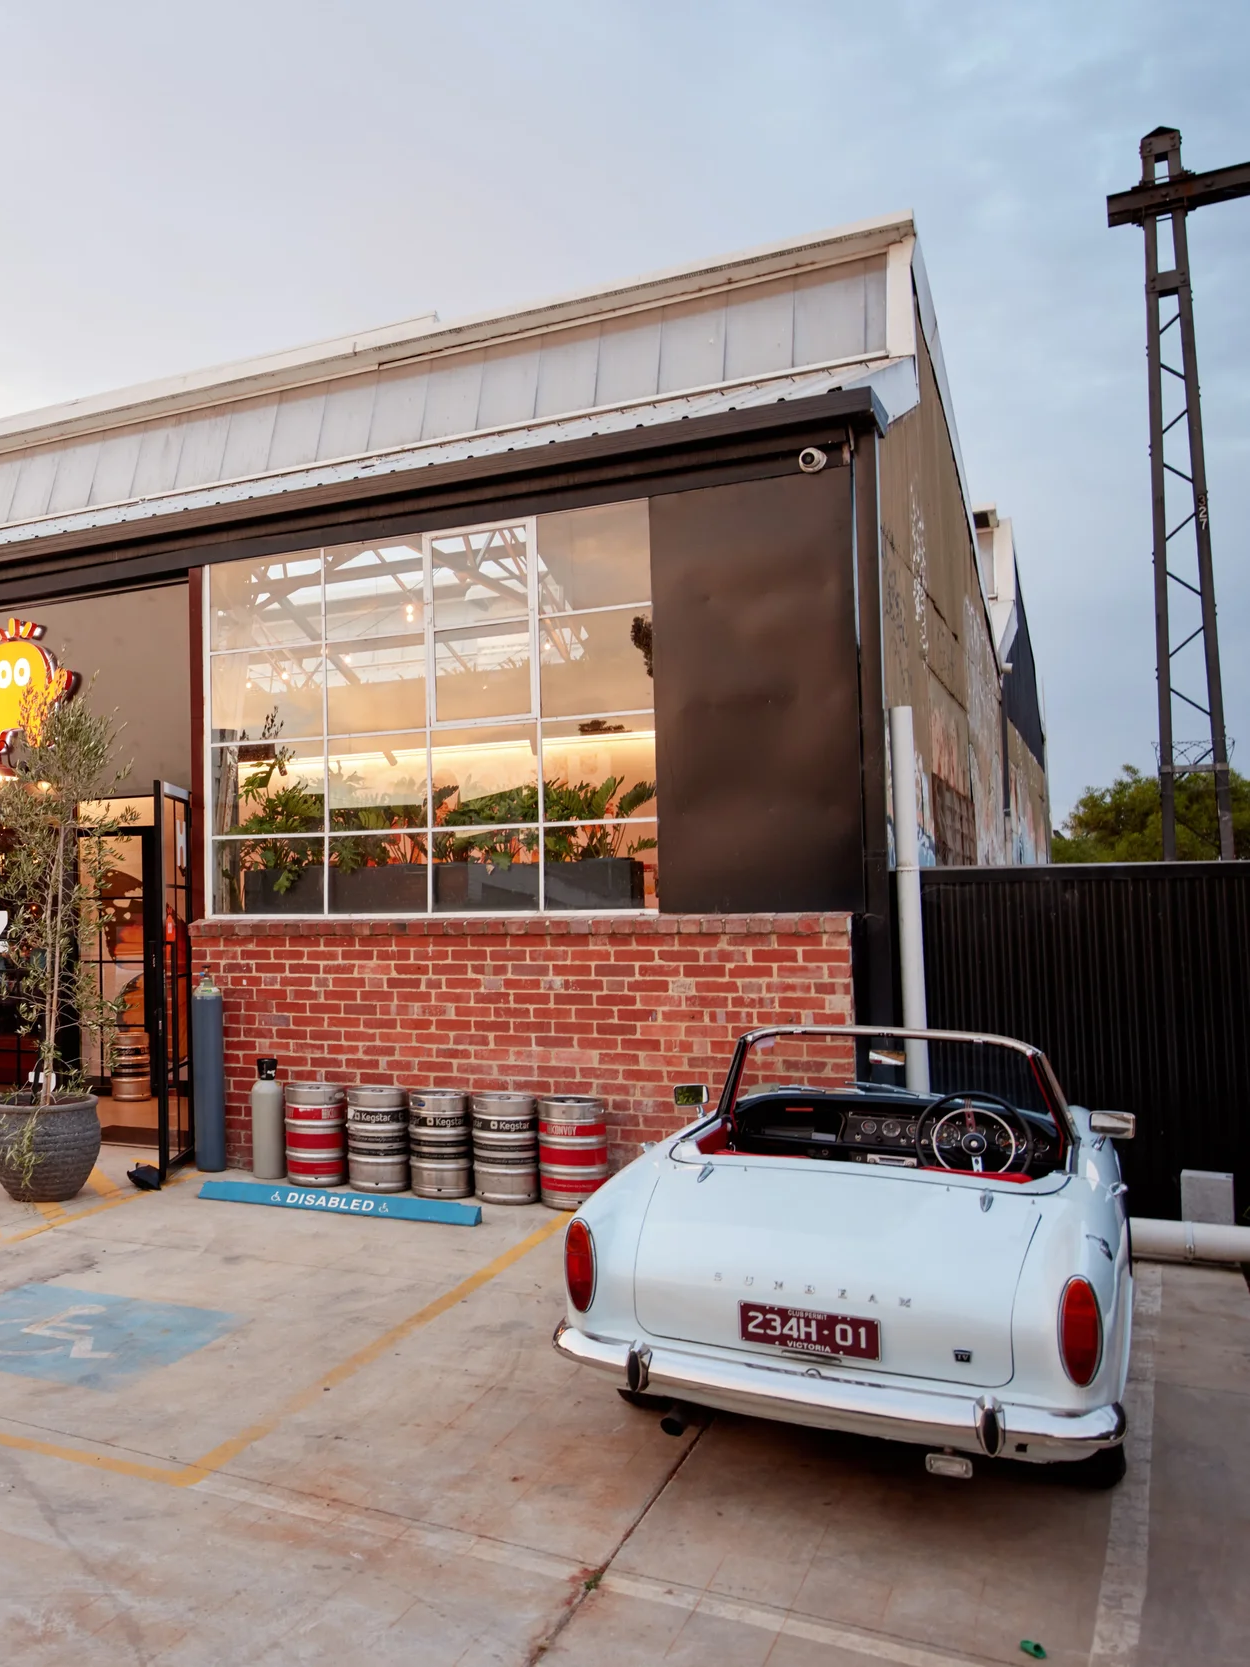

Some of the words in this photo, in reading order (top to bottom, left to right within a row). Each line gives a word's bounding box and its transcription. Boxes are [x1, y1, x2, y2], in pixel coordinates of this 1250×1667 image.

[361, 1113, 392, 1123] Kegstar
[435, 1117, 464, 1128] Kegstar
[499, 1121, 530, 1132] Kegstar
[286, 1192, 374, 1212] DISABLED
[788, 1309, 804, 1317] CLUB
[804, 1311, 827, 1321] PERMIT
[786, 1340, 831, 1353] VICTORIA
